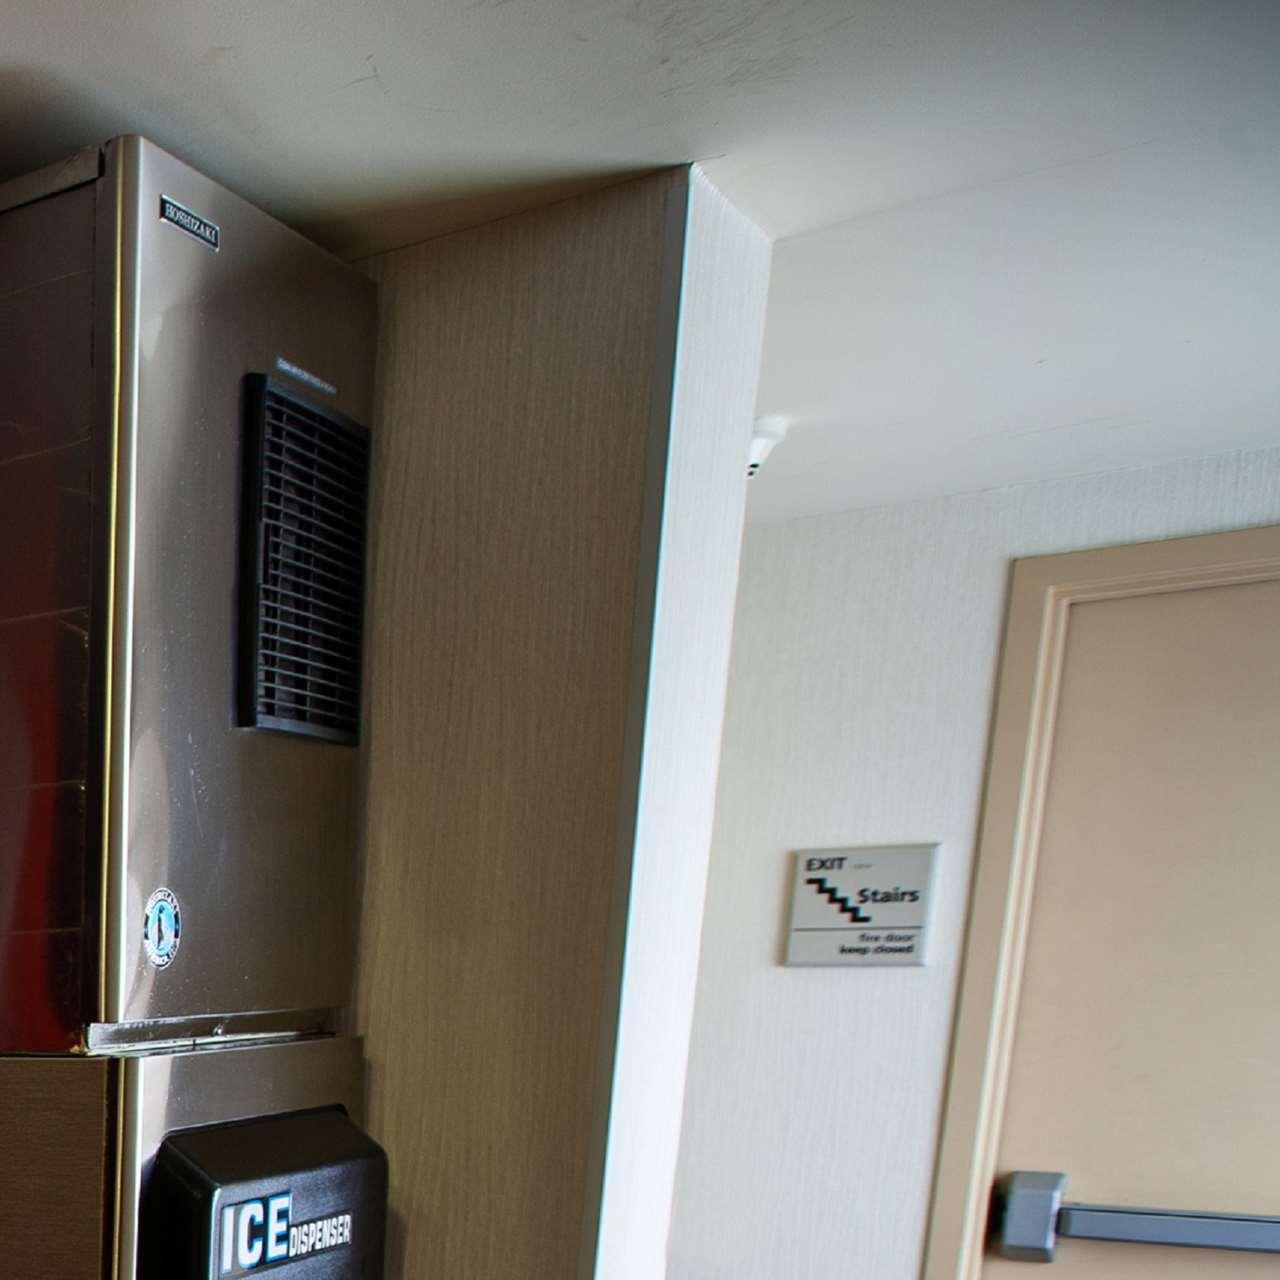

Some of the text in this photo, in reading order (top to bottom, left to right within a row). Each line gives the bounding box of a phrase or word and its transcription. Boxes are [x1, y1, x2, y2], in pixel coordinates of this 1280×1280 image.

[806, 857, 847, 871] EXIT
[858, 887, 920, 904] Stairs
[859, 933, 915, 942] fire door
[840, 944, 914, 955] keep closed
[221, 1193, 352, 1275] ICE DISPENSER
